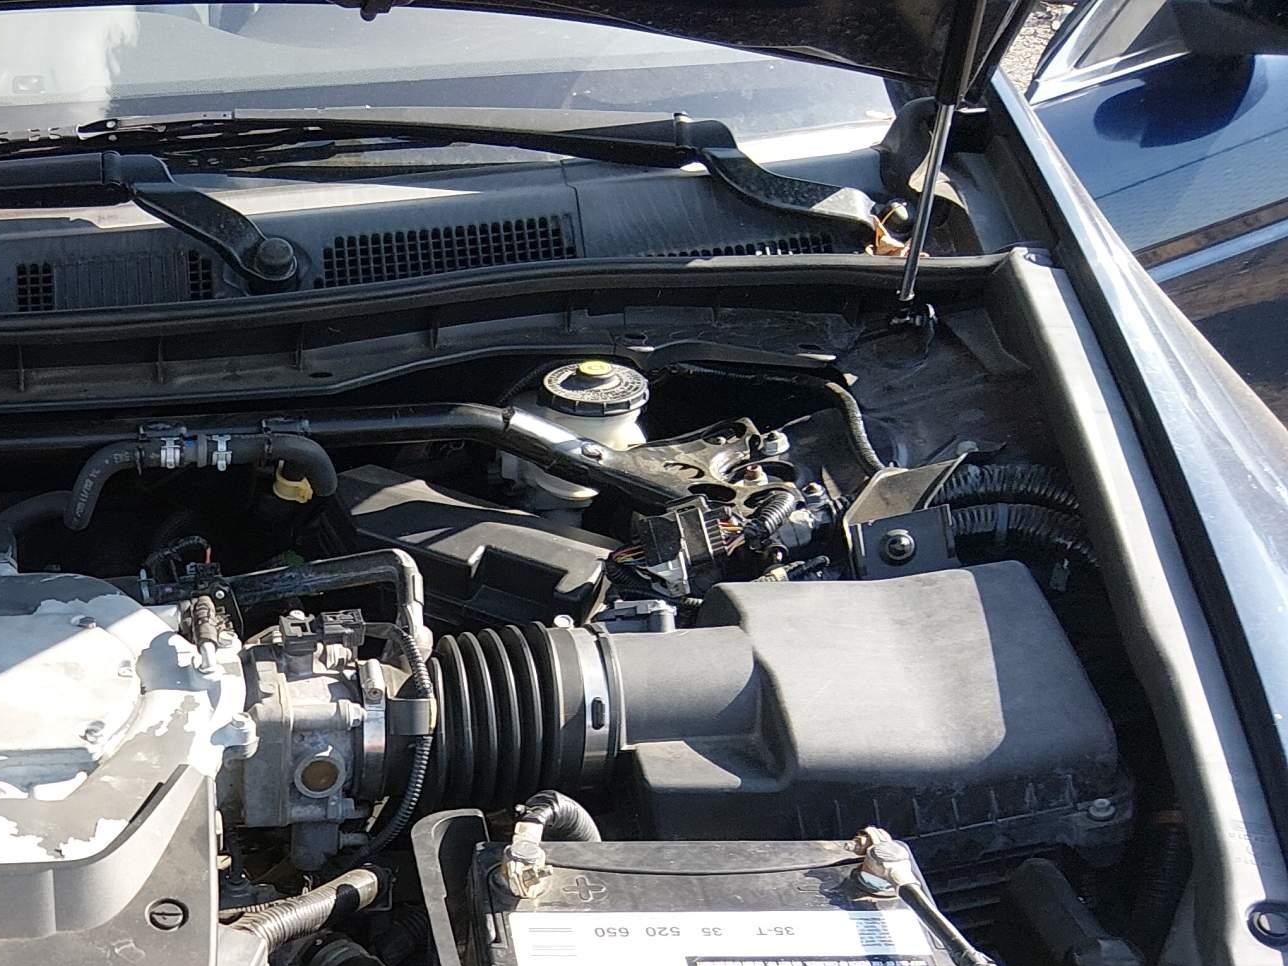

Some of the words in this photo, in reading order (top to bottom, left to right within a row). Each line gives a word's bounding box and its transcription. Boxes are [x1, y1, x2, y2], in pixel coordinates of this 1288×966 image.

[594, 926, 630, 937] 650
[645, 926, 681, 937] 520
[701, 926, 723, 936] 35
[755, 926, 795, 936] 35-T
